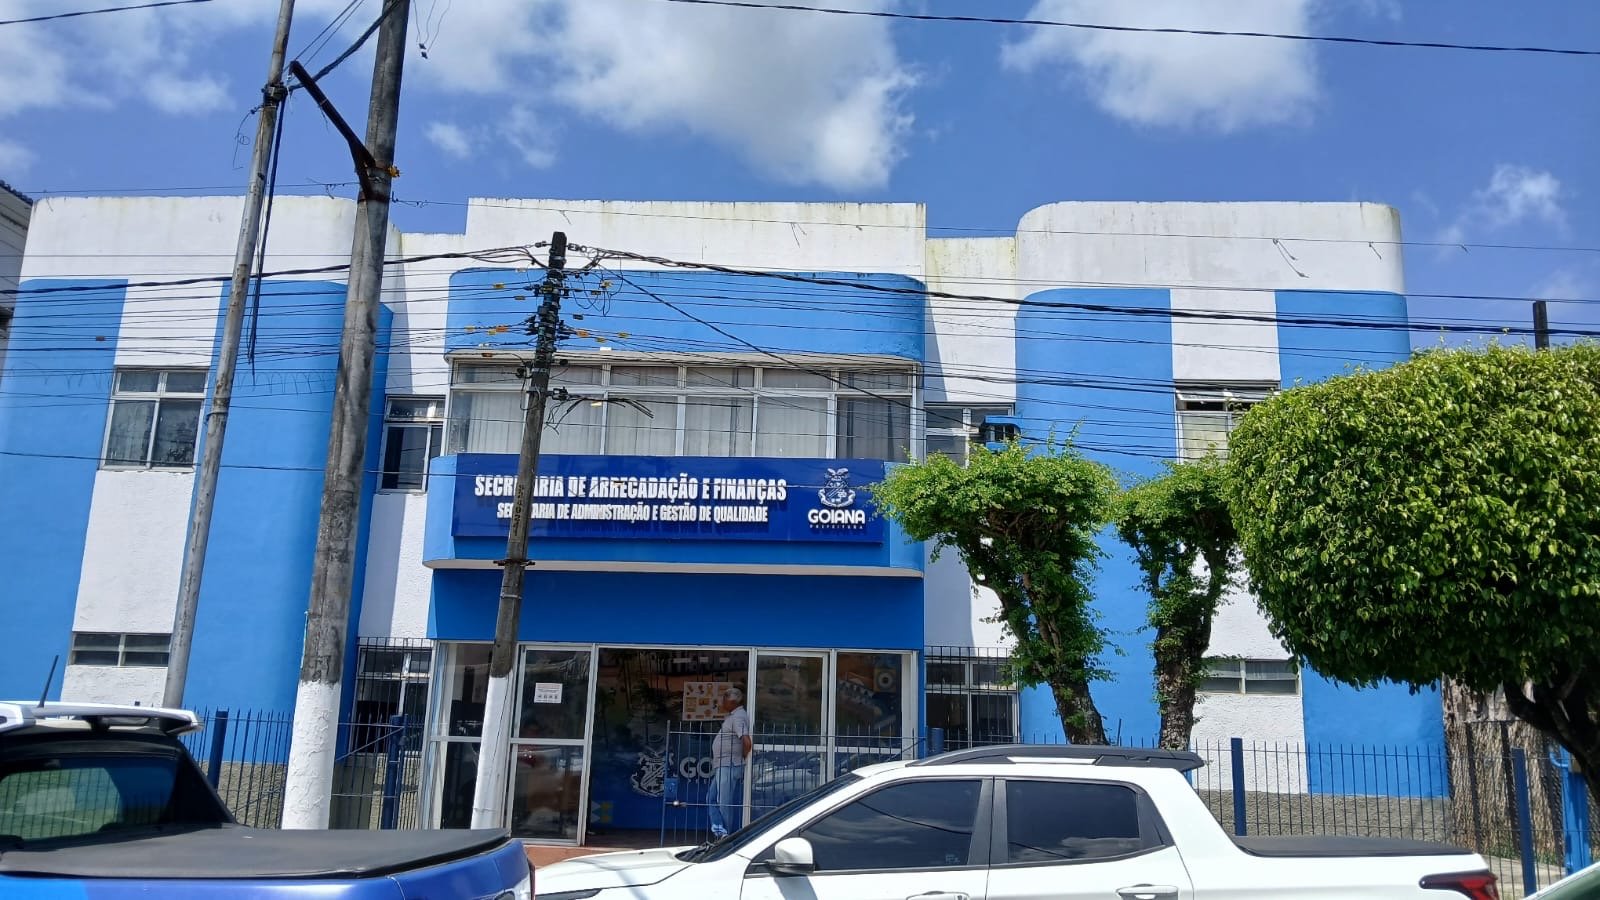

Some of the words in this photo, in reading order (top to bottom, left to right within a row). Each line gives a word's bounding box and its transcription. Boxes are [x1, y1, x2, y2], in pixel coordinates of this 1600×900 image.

[475, 475, 564, 497] SECRRIA
[567, 476, 587, 498] DE
[588, 473, 699, 503] ARRECADAÇÃO
[702, 477, 710, 499] E
[713, 478, 787, 504] FINANÇAS
[497, 503, 556, 519] SEARIA
[556, 504, 571, 520] DE
[571, 501, 650, 524] ADMINISTRAÇÃO
[652, 505, 659, 521] E
[660, 502, 697, 522] GESTÃO
[698, 505, 712, 521] DE
[714, 505, 769, 524] QUALIDADE
[807, 508, 866, 525] GOIANA
